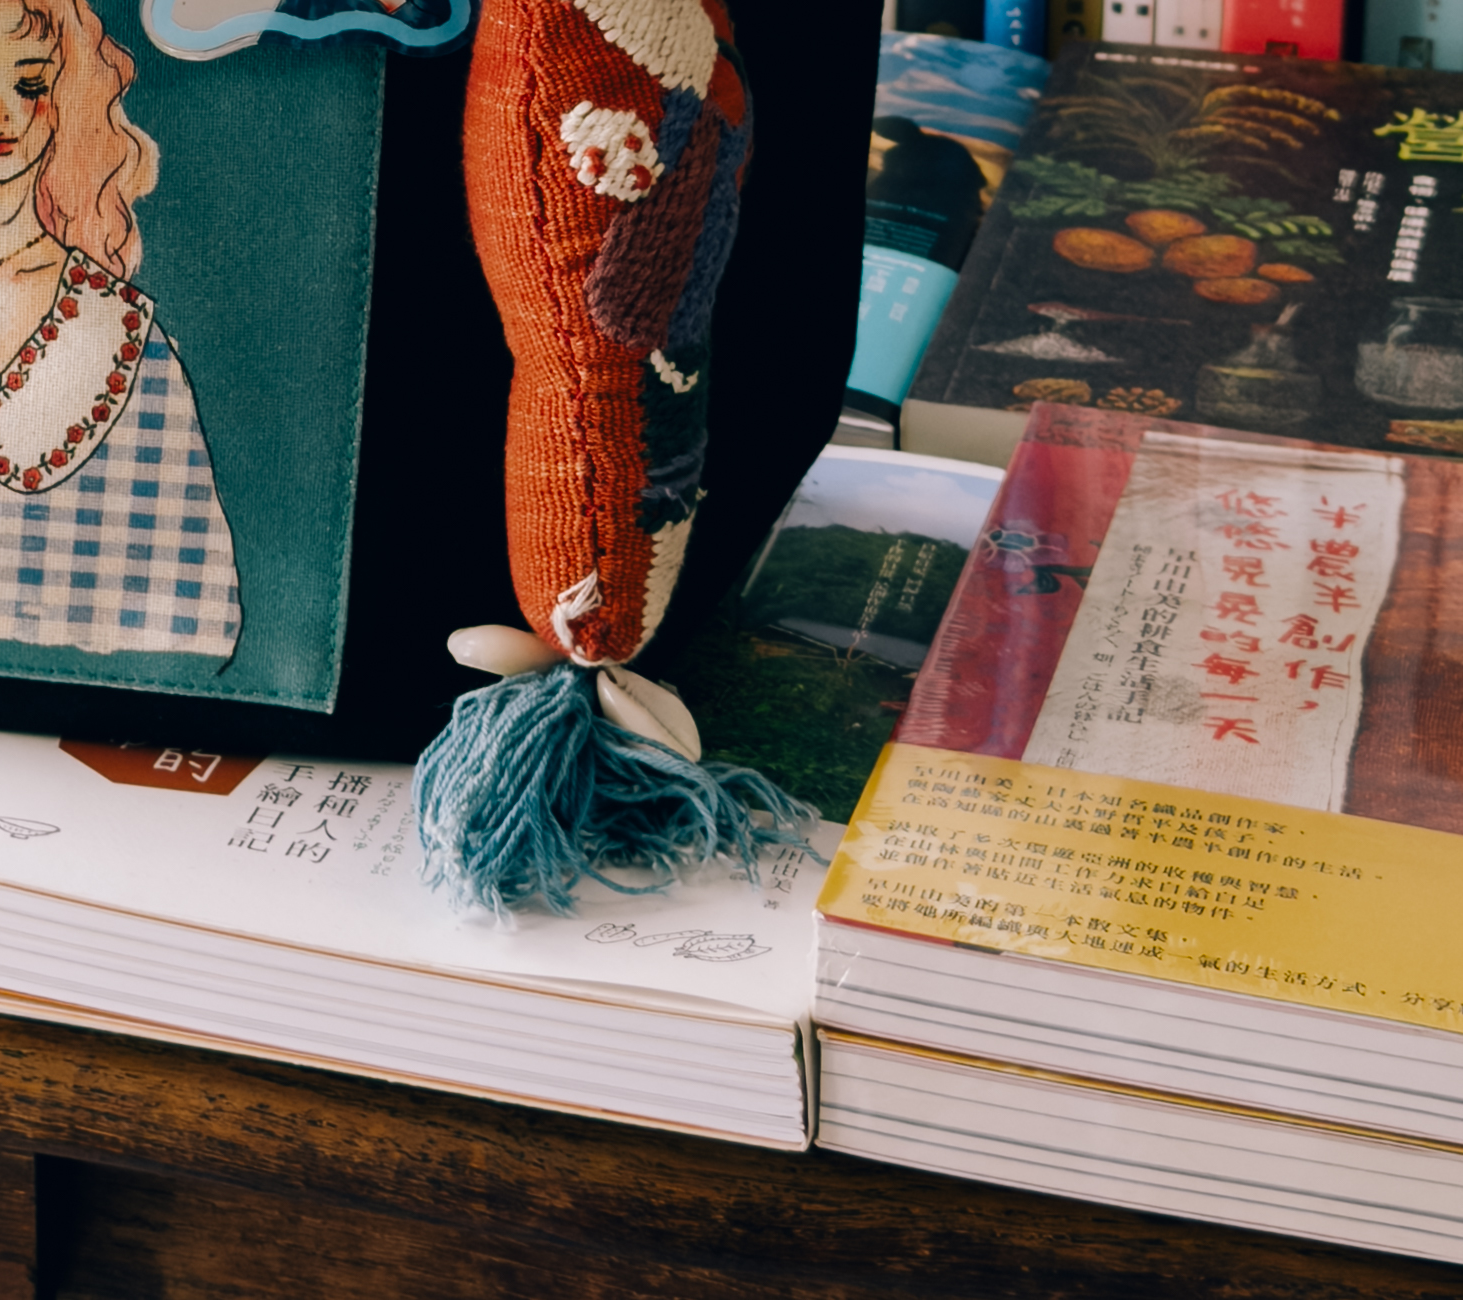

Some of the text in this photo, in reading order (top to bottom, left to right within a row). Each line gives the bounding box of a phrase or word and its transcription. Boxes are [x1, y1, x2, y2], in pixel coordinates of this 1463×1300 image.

[152, 747, 223, 783] 的
[227, 761, 315, 853] 手繪日記
[284, 771, 373, 864] 播種人的
[861, 892, 1463, 1014] 要將她所編織與大地連成一氣的生活方式，分享
